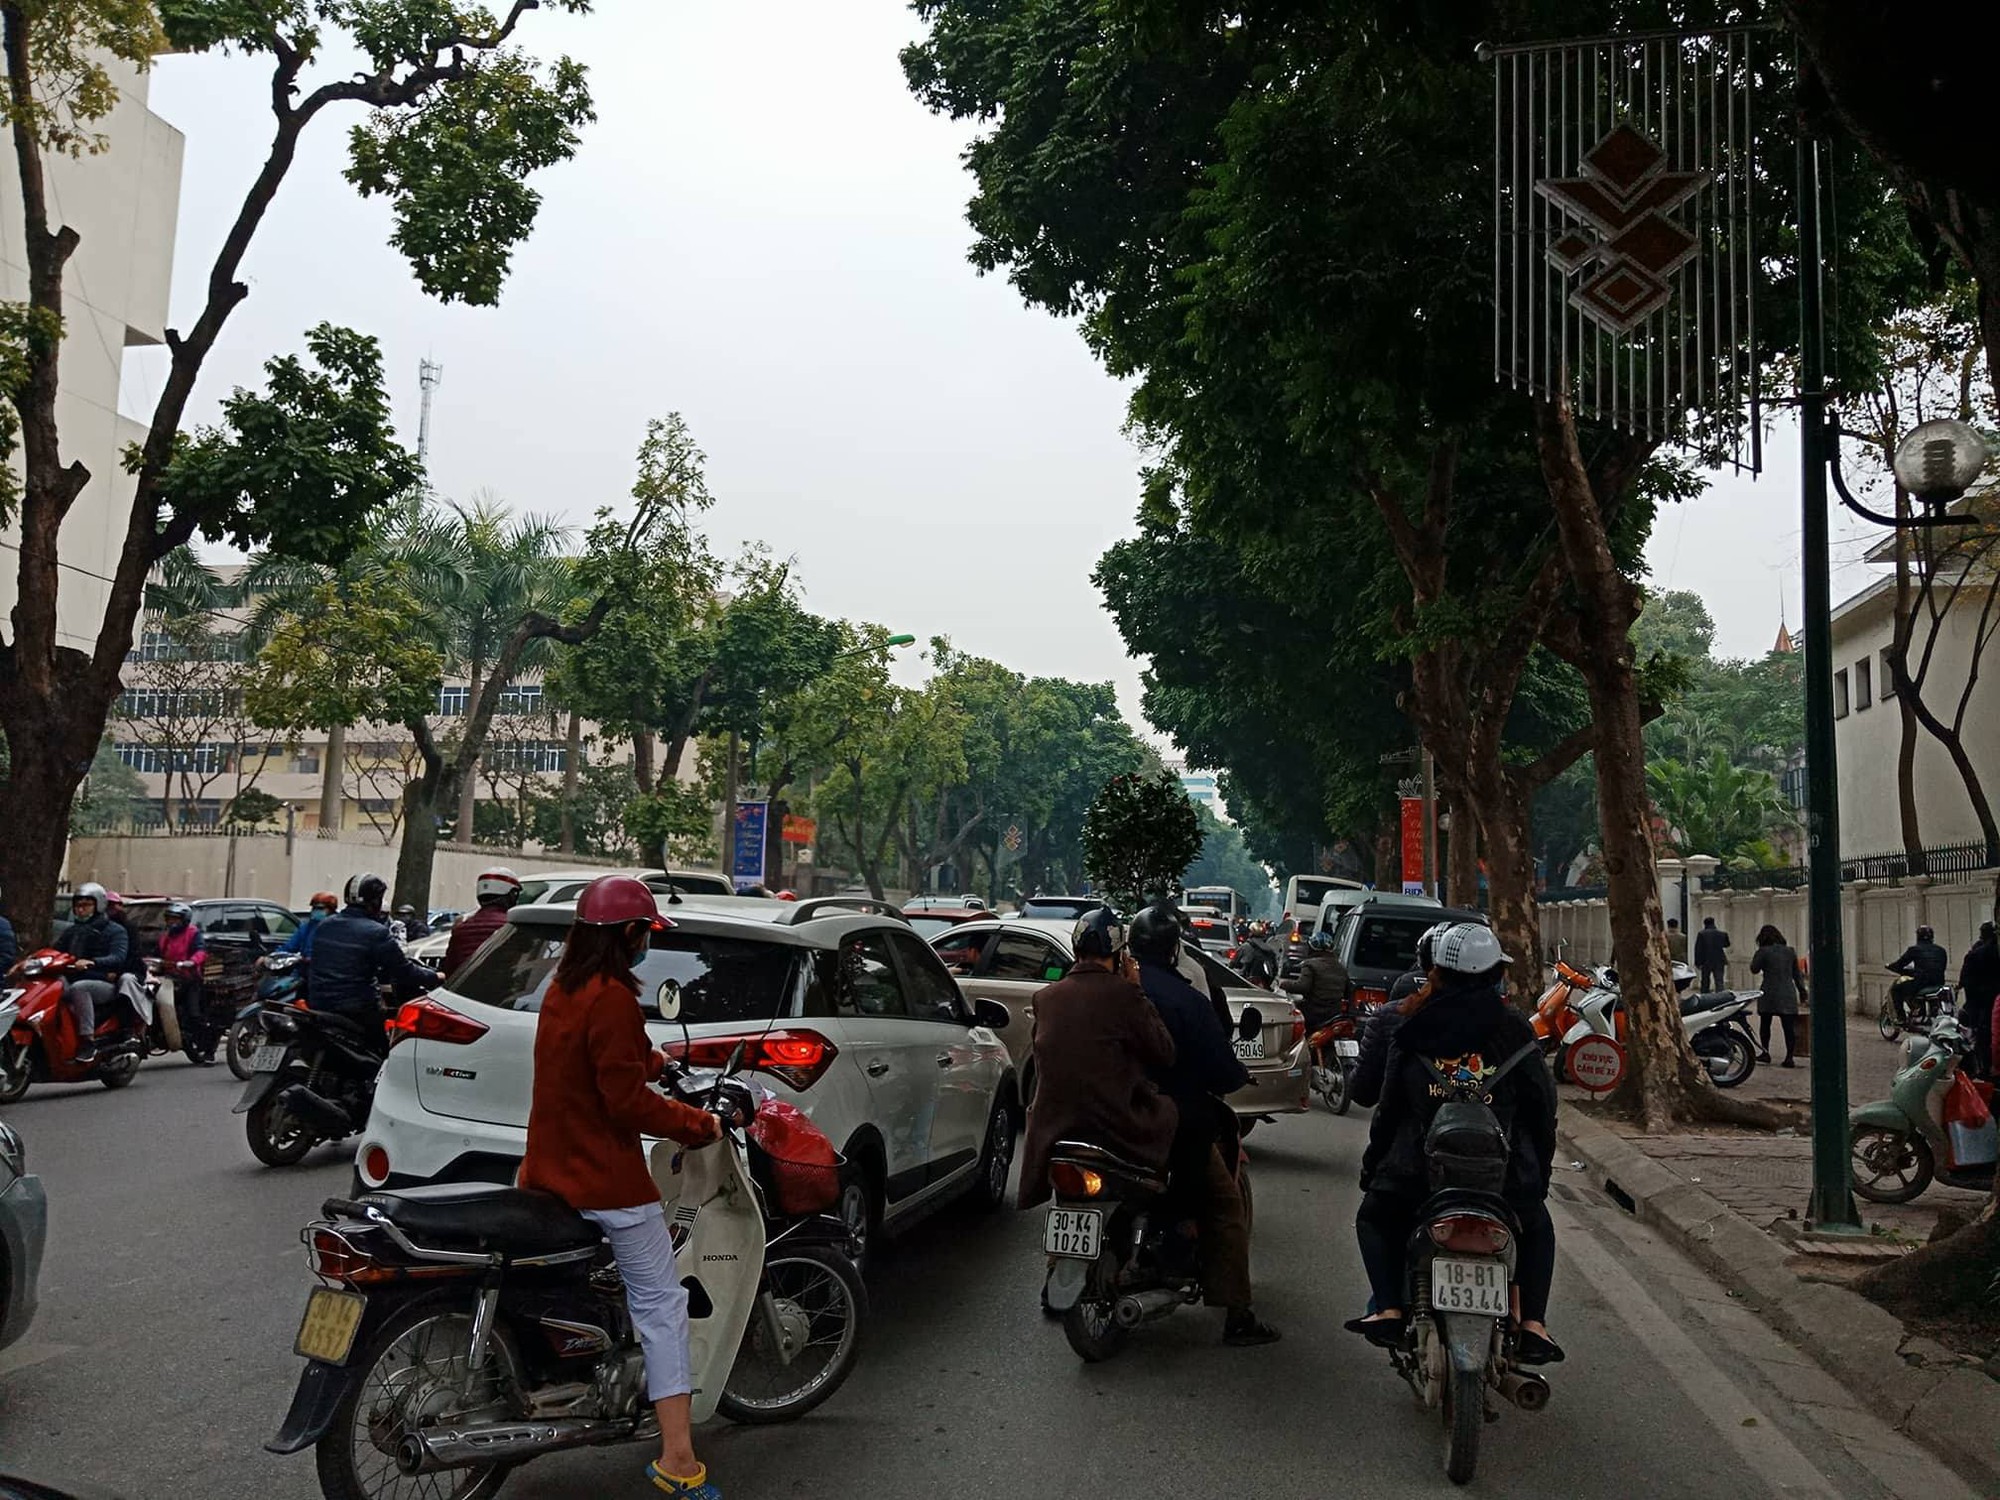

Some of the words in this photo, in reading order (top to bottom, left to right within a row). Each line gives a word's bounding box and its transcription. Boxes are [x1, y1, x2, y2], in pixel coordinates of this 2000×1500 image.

[1053, 1212, 1091, 1233] 30-K4
[1053, 1232, 1090, 1254] 1026
[702, 1254, 739, 1262] HONDA
[1444, 1262, 1495, 1288] 18-B1
[1438, 1285, 1504, 1312] 453.44
